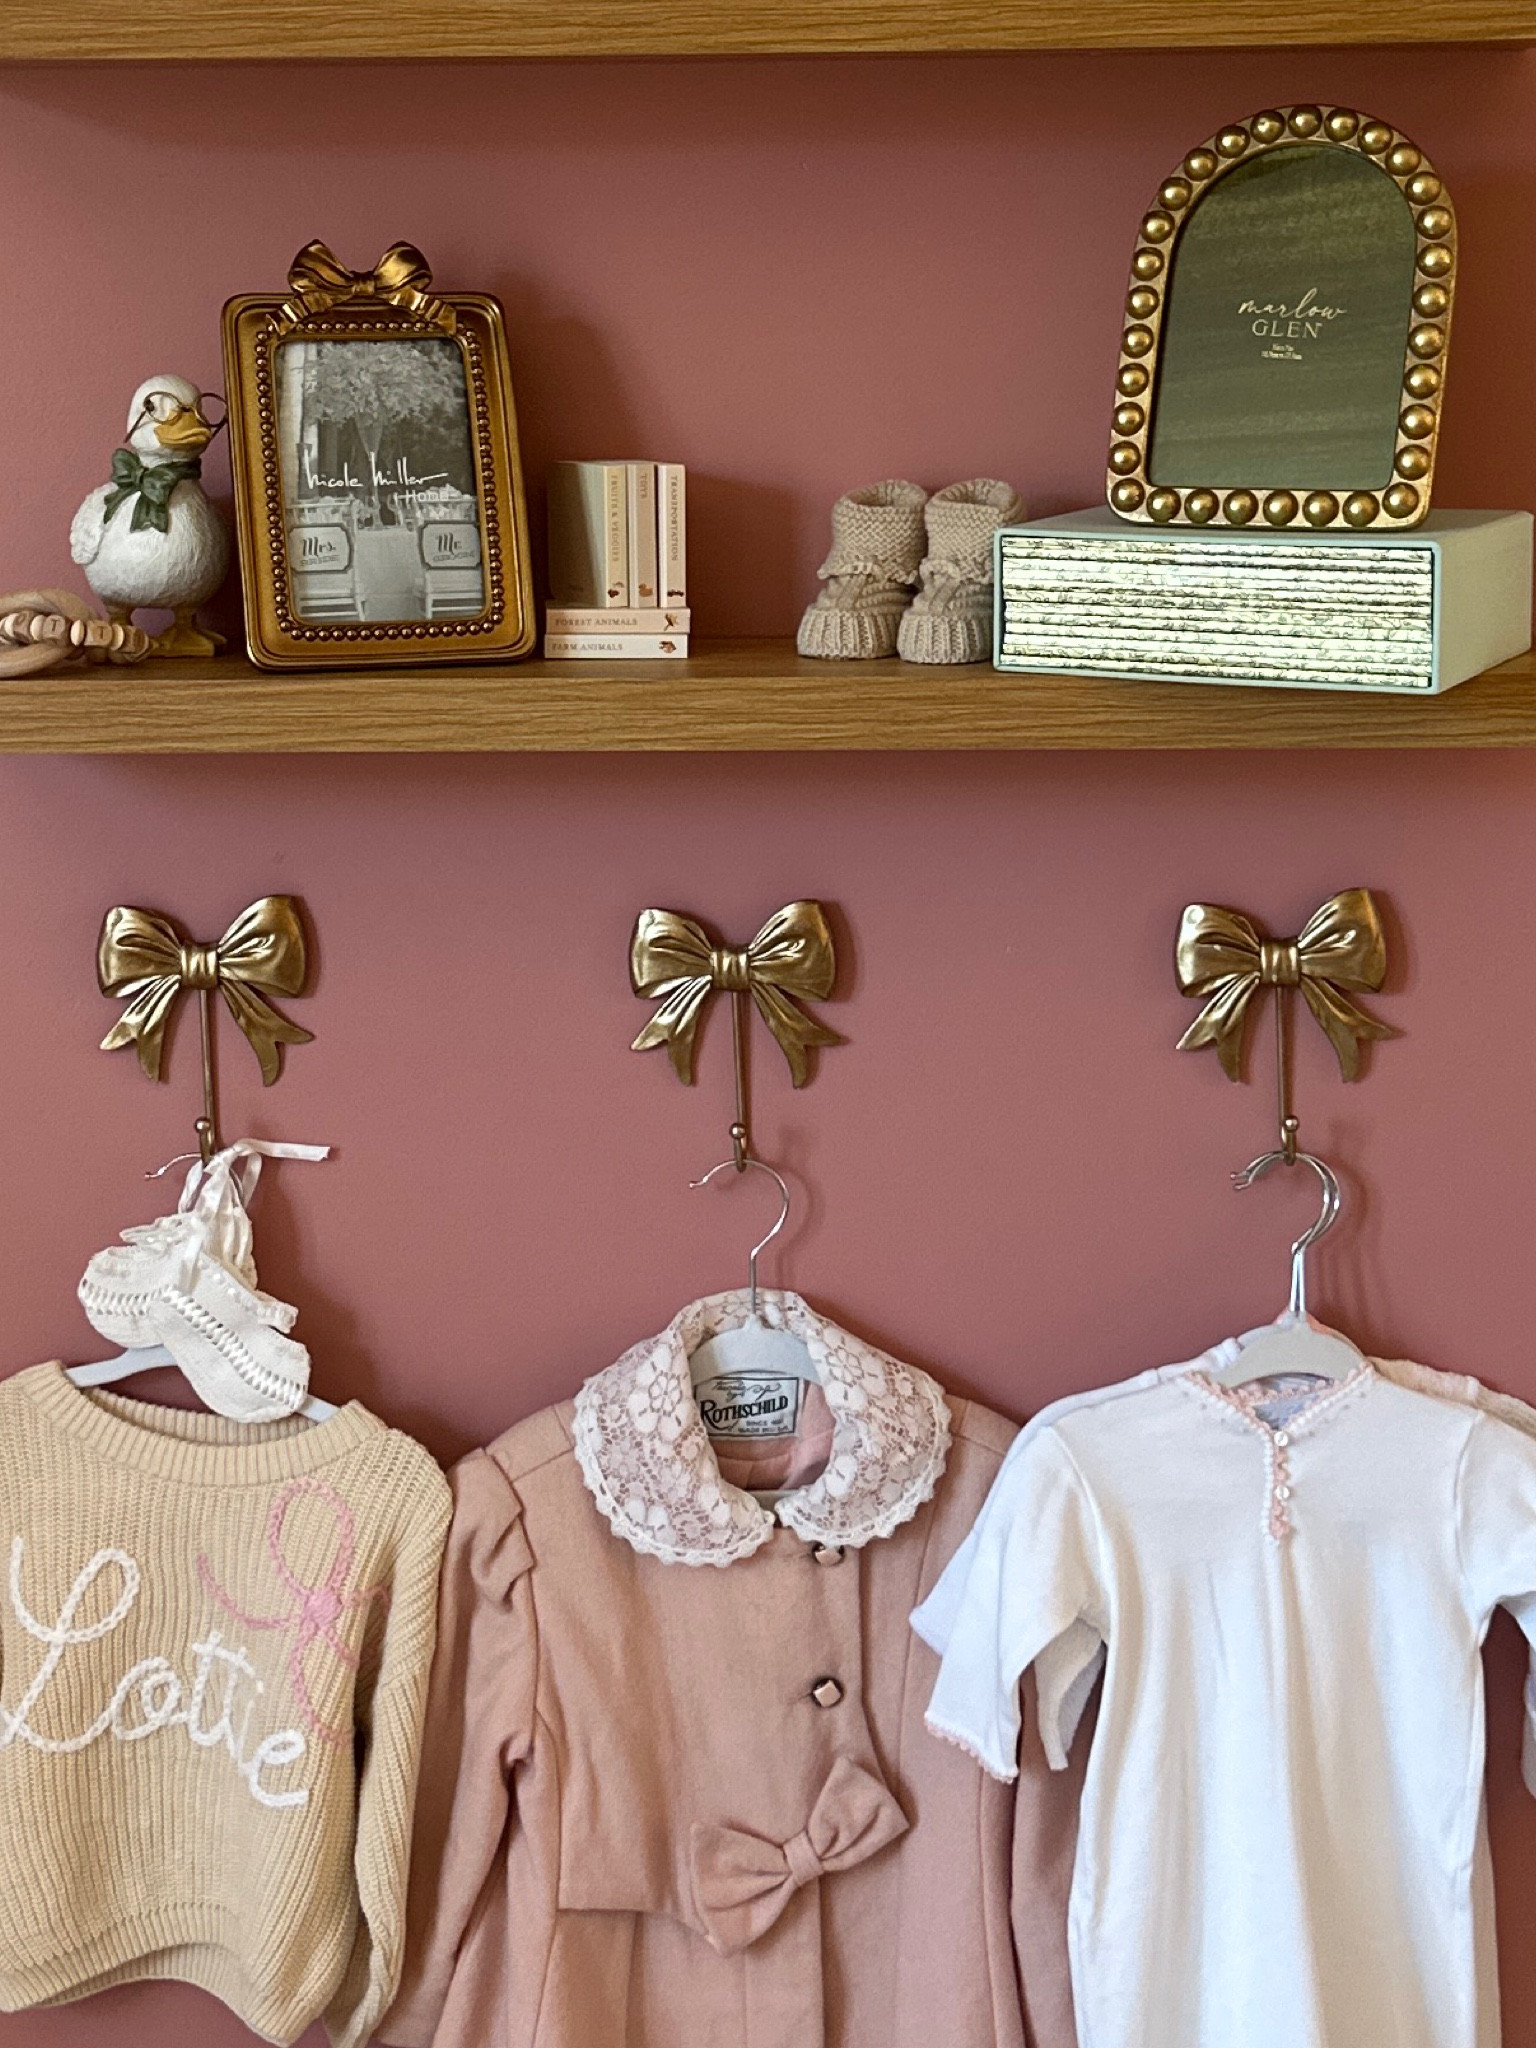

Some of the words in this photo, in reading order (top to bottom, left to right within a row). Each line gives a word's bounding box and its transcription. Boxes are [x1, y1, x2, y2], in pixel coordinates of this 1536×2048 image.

[1251, 318, 1323, 339] GLEN
[303, 447, 363, 490] Nicole
[370, 451, 449, 487] Miller
[639, 472, 649, 499] TOYS
[670, 475, 680, 562] TRANSPORTATION
[554, 617, 592, 627] FOREST
[594, 617, 638, 627] ANIMALS
[551, 642, 578, 651] FARM
[580, 642, 624, 651] ANIMALS
[700, 1395, 789, 1430] ROTHSCHILD
